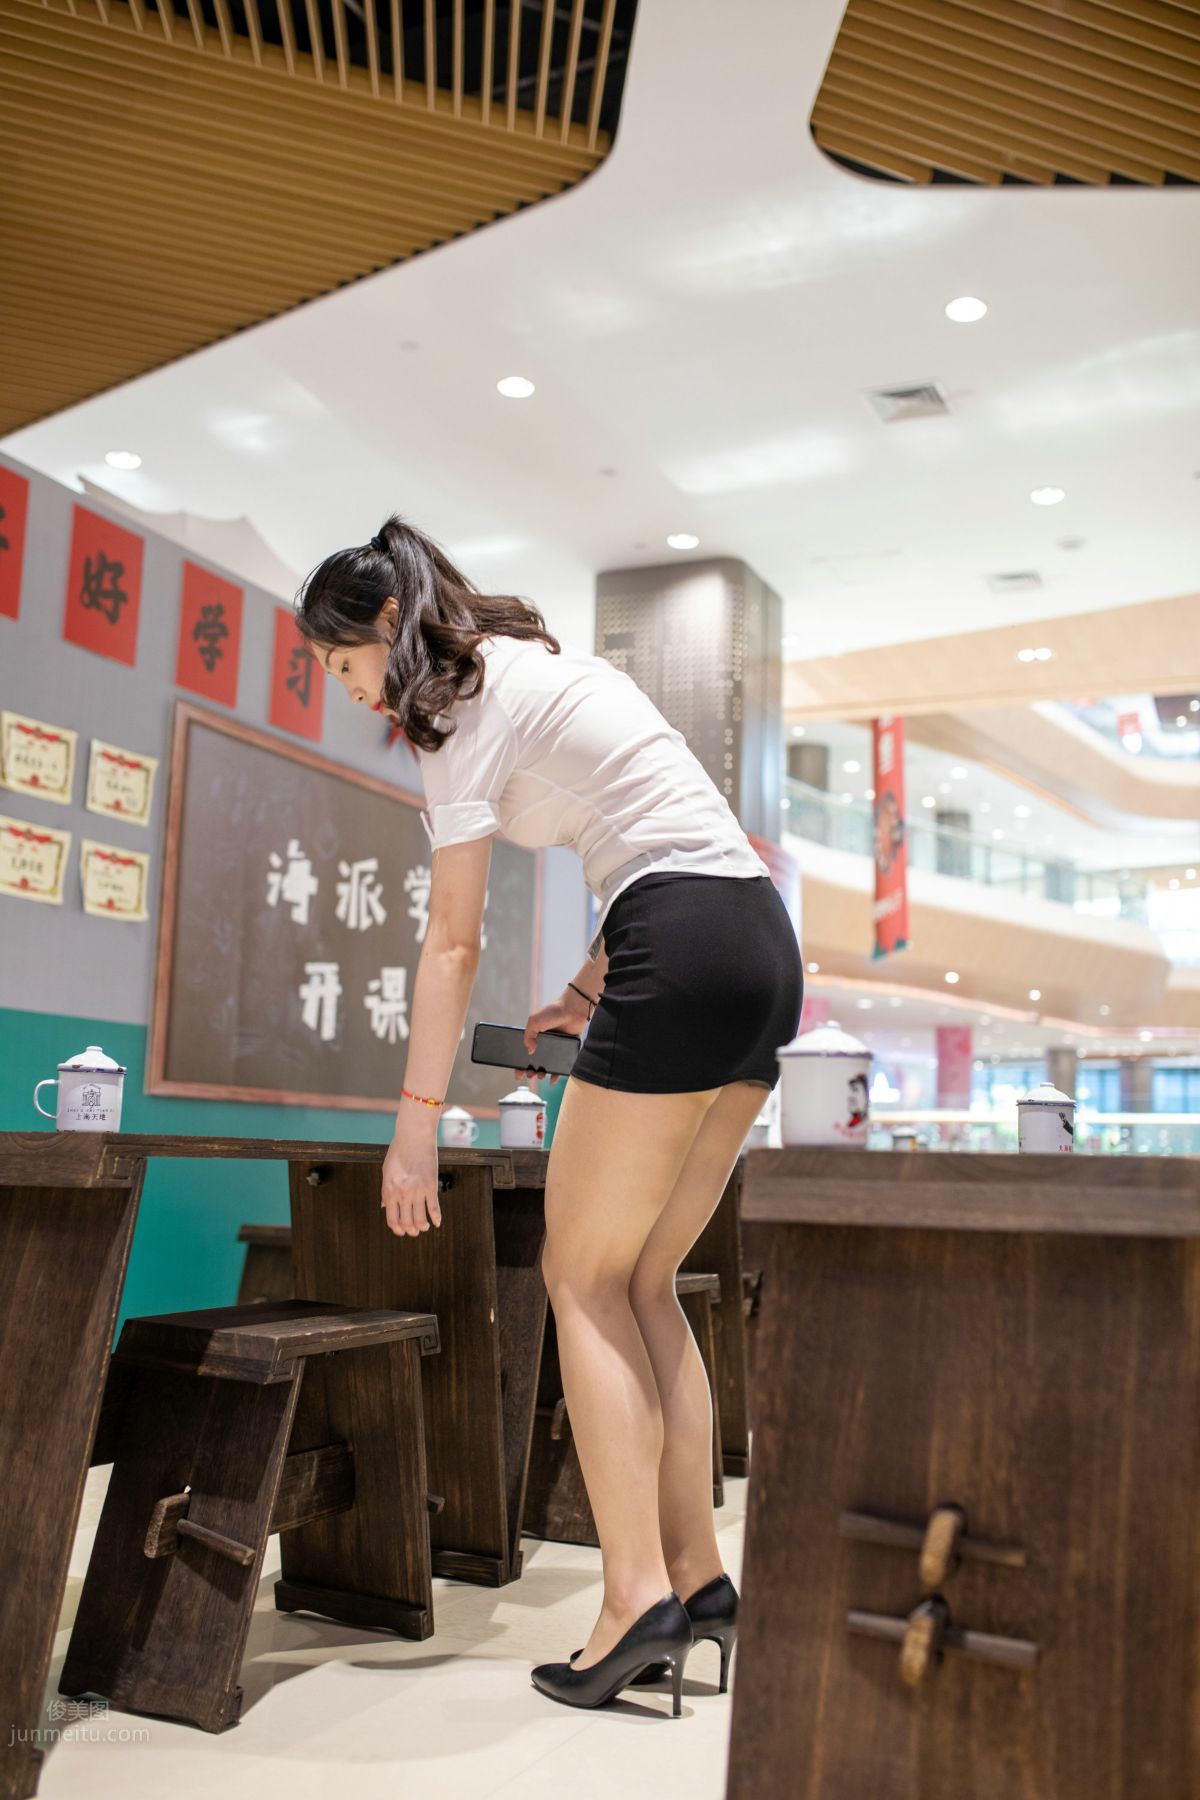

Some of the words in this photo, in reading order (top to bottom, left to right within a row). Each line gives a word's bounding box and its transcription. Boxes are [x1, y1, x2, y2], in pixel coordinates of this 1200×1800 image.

[79, 550, 128, 625] 好
[192, 602, 229, 673] 学
[266, 838, 488, 950] 海派学
